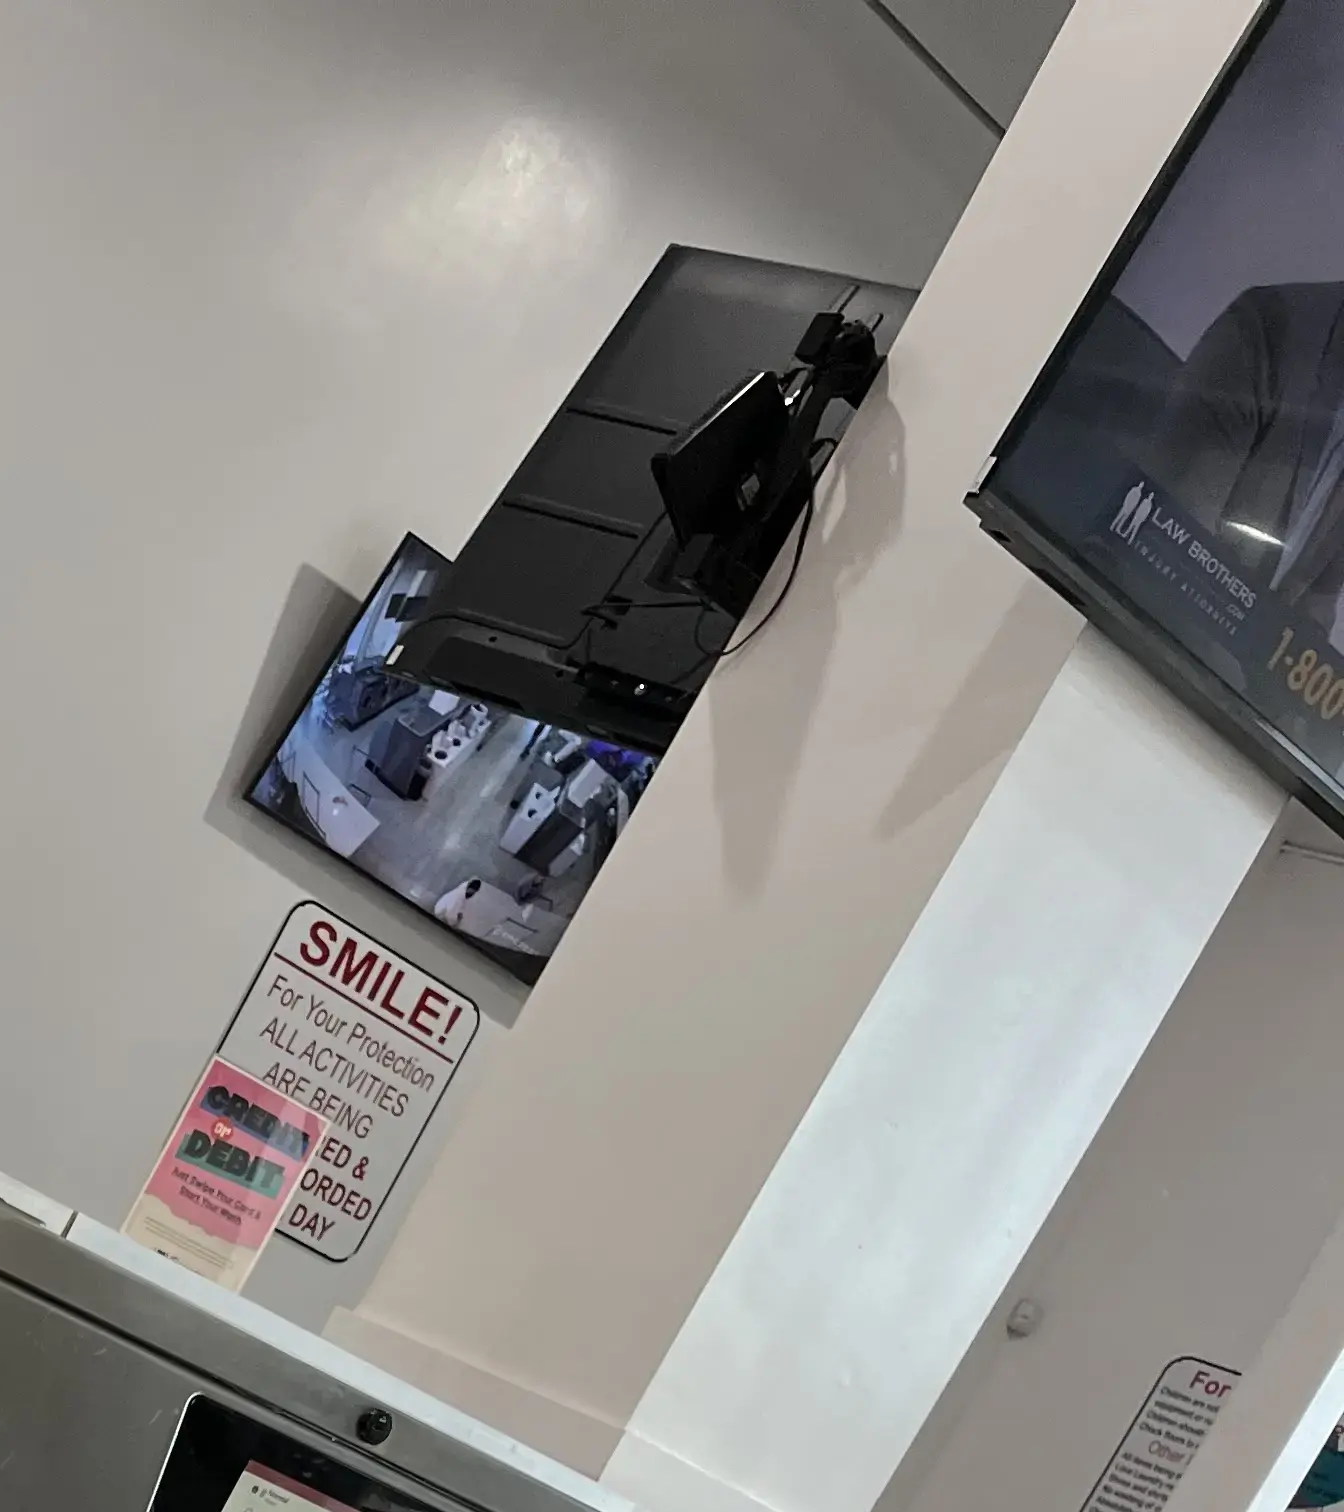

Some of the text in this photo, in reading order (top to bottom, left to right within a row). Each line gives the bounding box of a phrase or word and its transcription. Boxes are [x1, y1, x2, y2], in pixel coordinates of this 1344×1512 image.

[1151, 507, 1257, 609] LAW BROTHERS
[300, 921, 463, 1045] SMILE!
[260, 1018, 409, 1118] ALL ACTIVITIES
[267, 974, 435, 1093] For Your Protection
[263, 1062, 374, 1139] ARE BEING
[178, 1129, 285, 1194] DEBIT
[300, 1169, 372, 1222] ORDED
[352, 1156, 370, 1180] &
[288, 1203, 336, 1242] DAY
[1189, 1370, 1232, 1398] For
